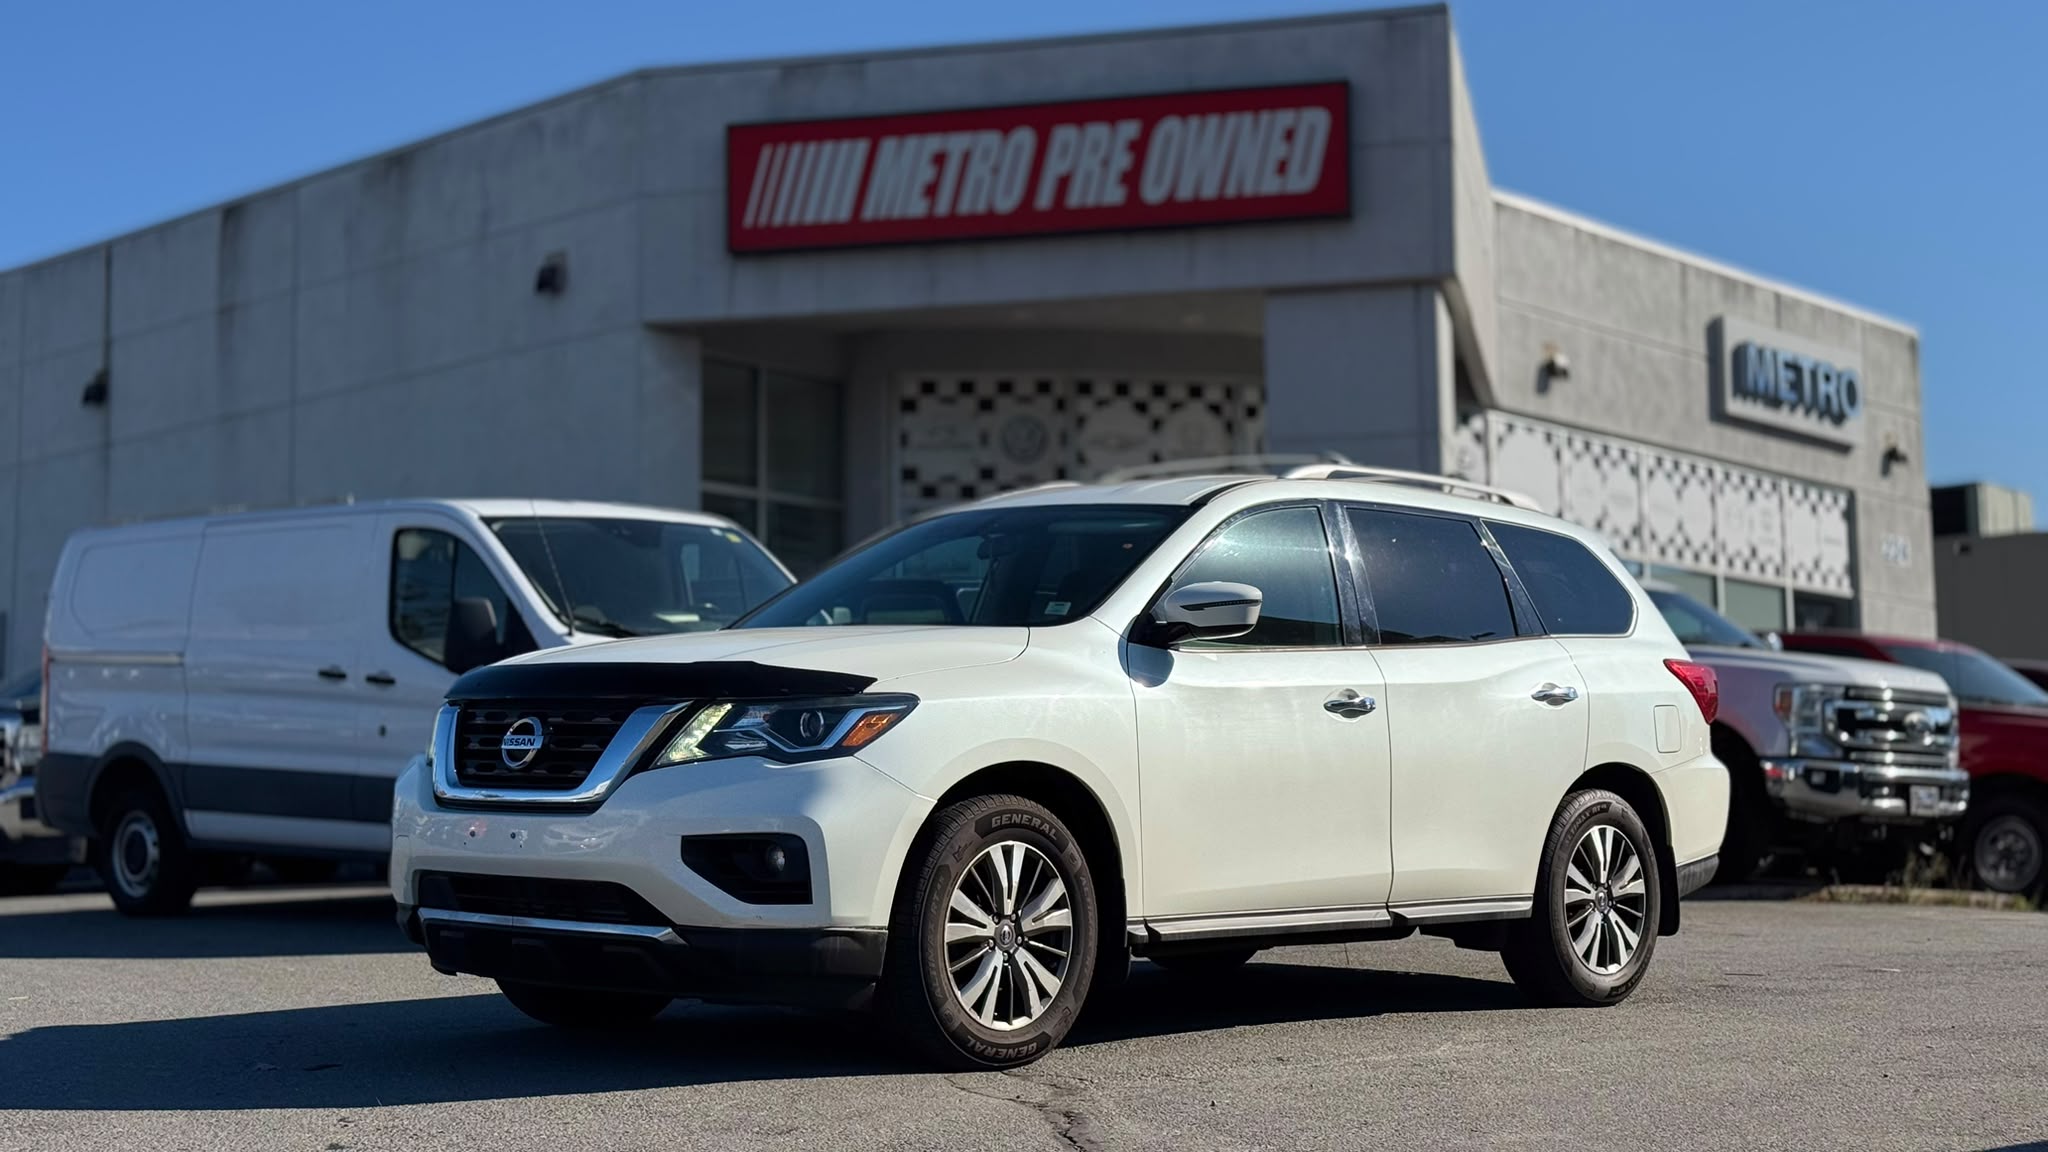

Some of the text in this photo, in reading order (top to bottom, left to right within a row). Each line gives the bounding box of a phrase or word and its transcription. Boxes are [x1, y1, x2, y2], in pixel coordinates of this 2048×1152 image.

[860, 106, 1332, 222] METRO PRE OWNED
[1745, 340, 1863, 418] METRO
[503, 737, 536, 746] NISSAN
[991, 813, 1058, 841] GENERAL
[967, 1034, 1038, 1059] GENERAL
